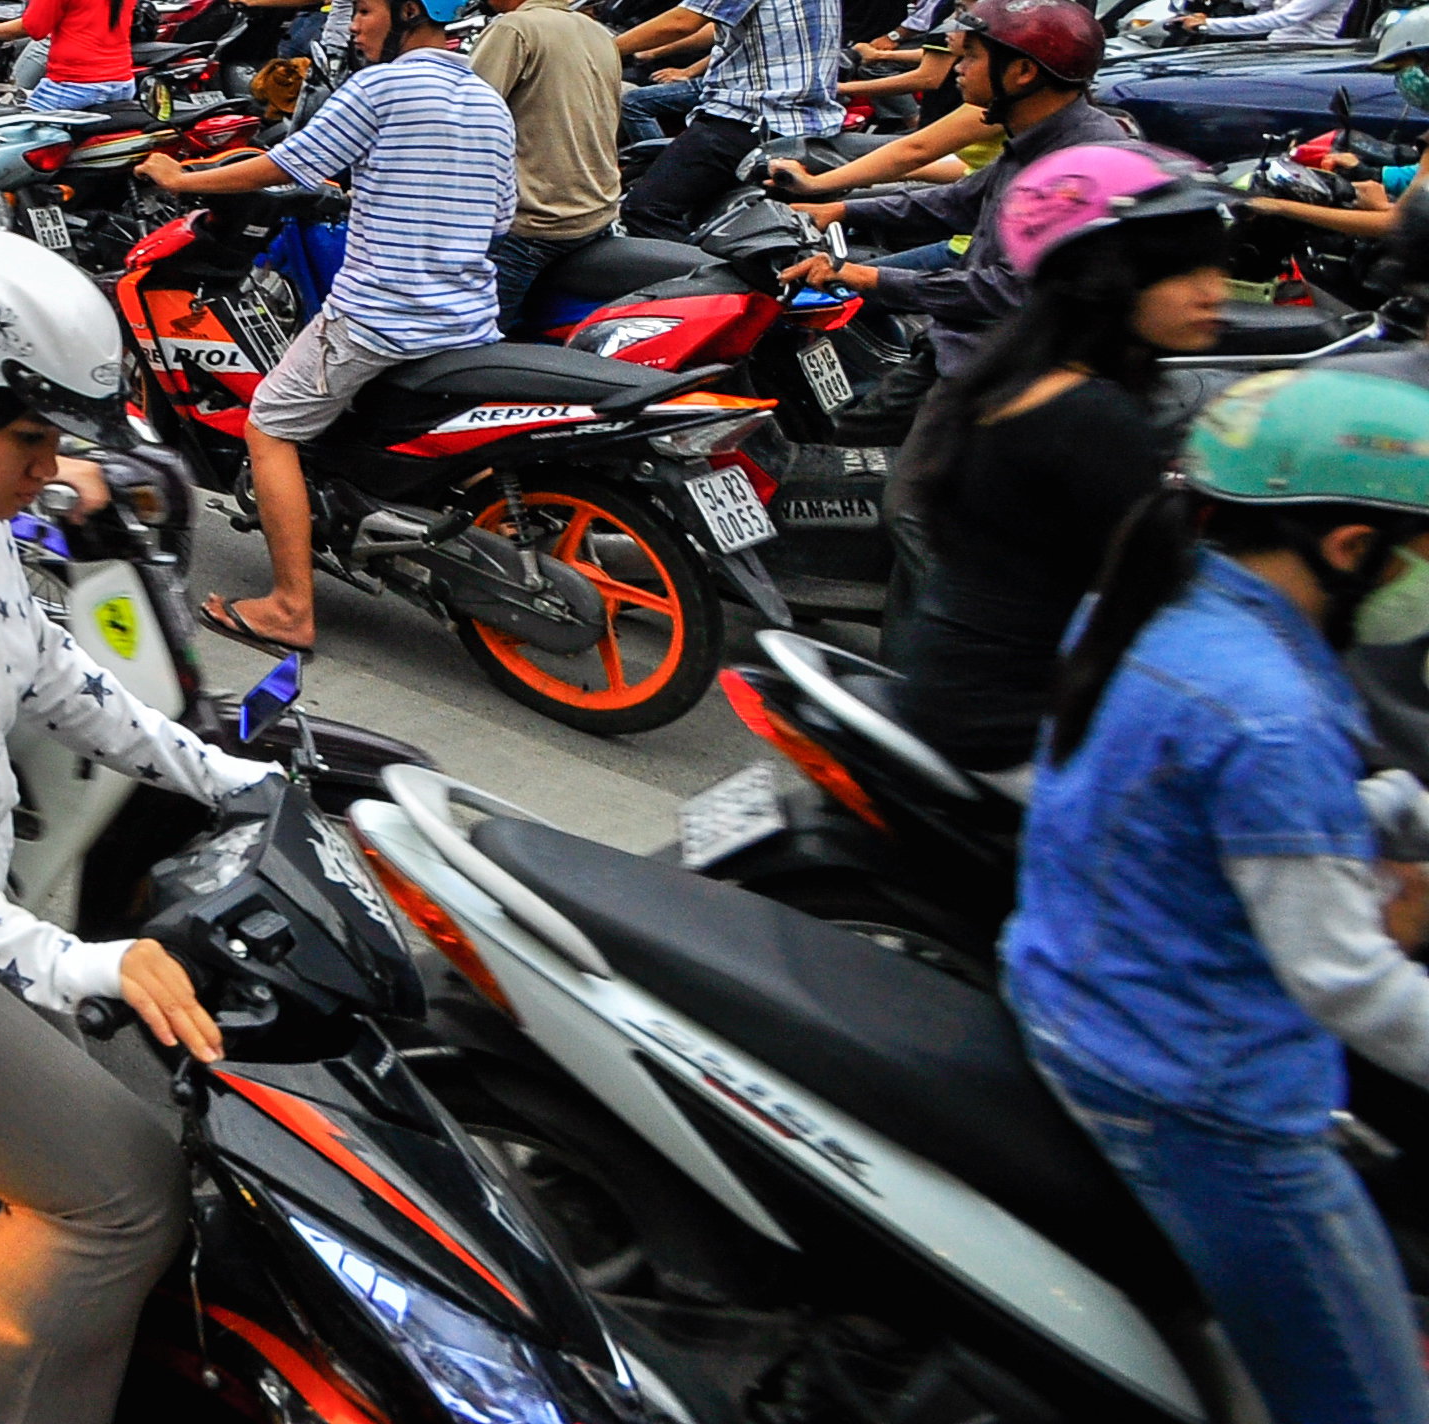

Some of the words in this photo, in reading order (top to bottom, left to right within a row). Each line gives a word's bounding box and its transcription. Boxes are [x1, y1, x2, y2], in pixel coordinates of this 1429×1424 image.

[468, 405, 573, 424] REPSOL
[698, 473, 748, 513] 54-R3
[781, 496, 873, 521] YAMAHA
[716, 504, 766, 544] 0055
